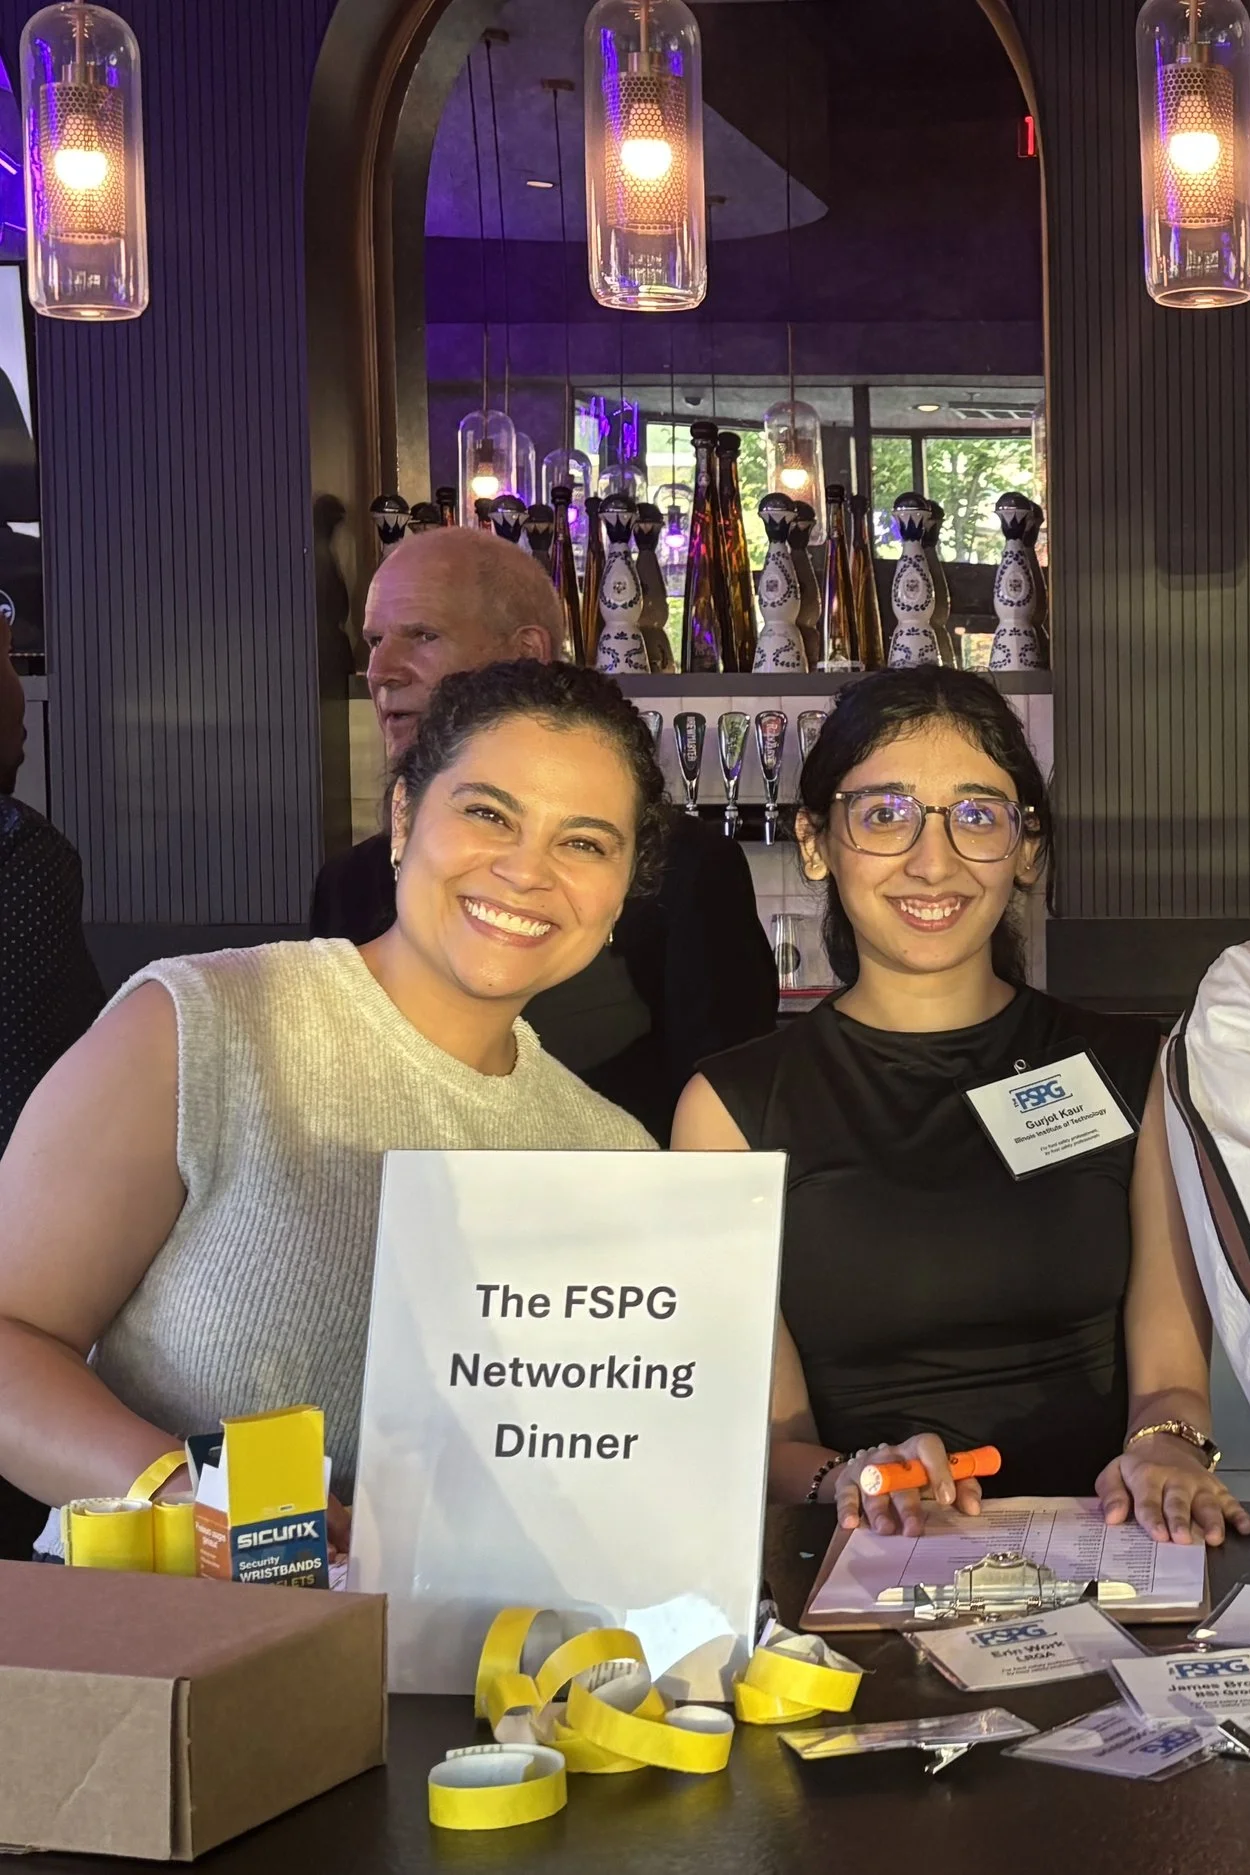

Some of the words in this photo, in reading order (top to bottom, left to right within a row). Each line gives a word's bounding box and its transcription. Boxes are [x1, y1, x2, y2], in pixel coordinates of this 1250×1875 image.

[1014, 1079, 1066, 1110] FSPG
[1013, 1133, 1036, 1145] Illinois
[1036, 1123, 1063, 1138] Institute
[1063, 1119, 1070, 1129] of
[1070, 1107, 1107, 1124] Technology
[1025, 1112, 1059, 1131] Gurjot
[1059, 1103, 1085, 1118] Kaur
[475, 1284, 551, 1319] The
[564, 1285, 677, 1320] FSPG
[449, 1352, 696, 1399] Networking
[494, 1423, 639, 1460] Dinner
[239, 1555, 280, 1572] Security
[239, 1557, 322, 1584] WRISTBANDS
[976, 1623, 1048, 1647] FSPG
[990, 1648, 1024, 1660] Erin
[1024, 1639, 1066, 1654] Work
[1175, 1658, 1250, 1679] FSPG
[1168, 1681, 1221, 1693] James
